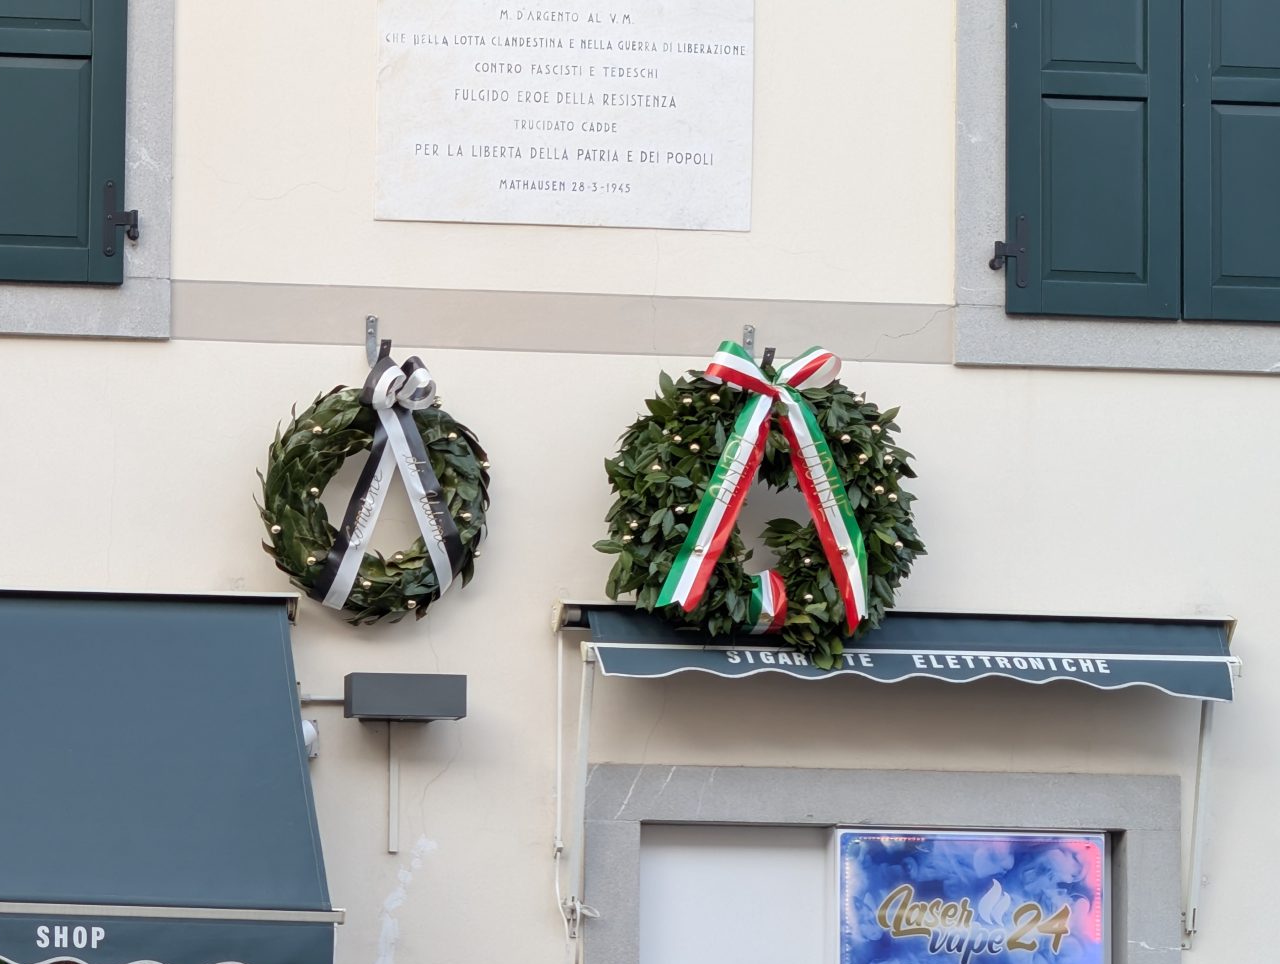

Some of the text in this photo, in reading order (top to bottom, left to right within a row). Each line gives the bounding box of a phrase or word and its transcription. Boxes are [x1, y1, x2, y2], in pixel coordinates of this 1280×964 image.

[588, 13, 601, 23] AL
[385, 32, 406, 44] CHE
[454, 35, 486, 46] LOTTA
[491, 36, 563, 49] CLANDESTINA
[569, 38, 575, 49] E
[580, 39, 613, 50] NELLA
[617, 40, 657, 52] GUERRA
[662, 42, 673, 53] DI
[677, 42, 746, 56] LIBERAZIONE
[474, 62, 659, 79] CONTRO FASCISTI E TEDESCHI
[454, 88, 677, 108] FULGIDO EROE DELLA RESISTENZA
[514, 119, 617, 133] TRUCIDATO CADDE
[415, 143, 439, 156] PER
[447, 144, 464, 157] LA
[530, 147, 569, 160] DELLA
[577, 148, 619, 162] PATRIA
[627, 150, 633, 163] E
[640, 150, 660, 164] DEI
[666, 151, 714, 166] POPOLI
[499, 179, 566, 192] MATHAUSEN
[725, 651, 1111, 674] SIGARTE ELETTRONICHE
[876, 883, 974, 938] Laser
[36, 925, 106, 949] SHOP
[1006, 902, 1071, 955] 24
